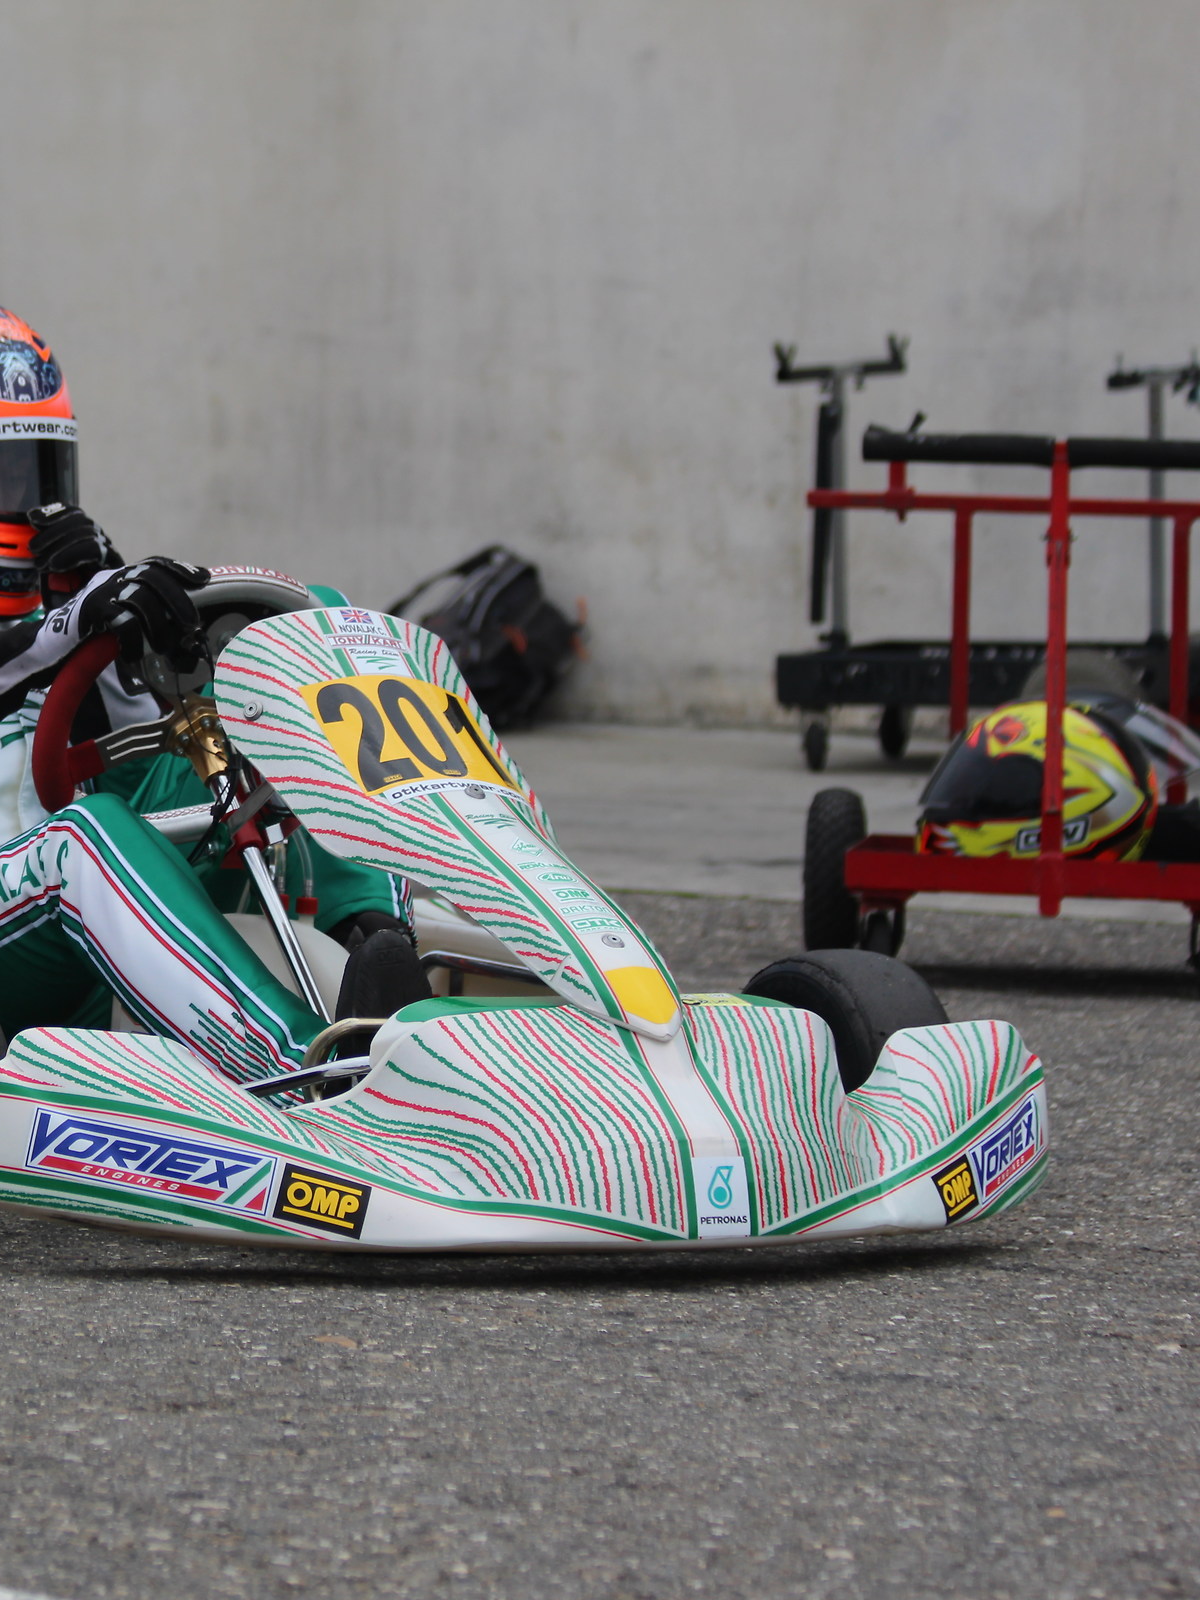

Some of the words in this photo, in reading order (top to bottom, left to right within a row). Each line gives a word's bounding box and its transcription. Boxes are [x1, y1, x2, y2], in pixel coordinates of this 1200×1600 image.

[339, 624, 378, 635] NOVALAK
[349, 648, 377, 656] Racing
[317, 679, 517, 792] 201
[556, 890, 590, 899] OMP
[33, 1113, 264, 1189] VORTEX
[971, 1101, 1034, 1198] VORTEX
[81, 1165, 180, 1192] ENGINES
[943, 1170, 971, 1208] OMP
[286, 1183, 361, 1219] OMP
[700, 1215, 748, 1225] PETRONAS
